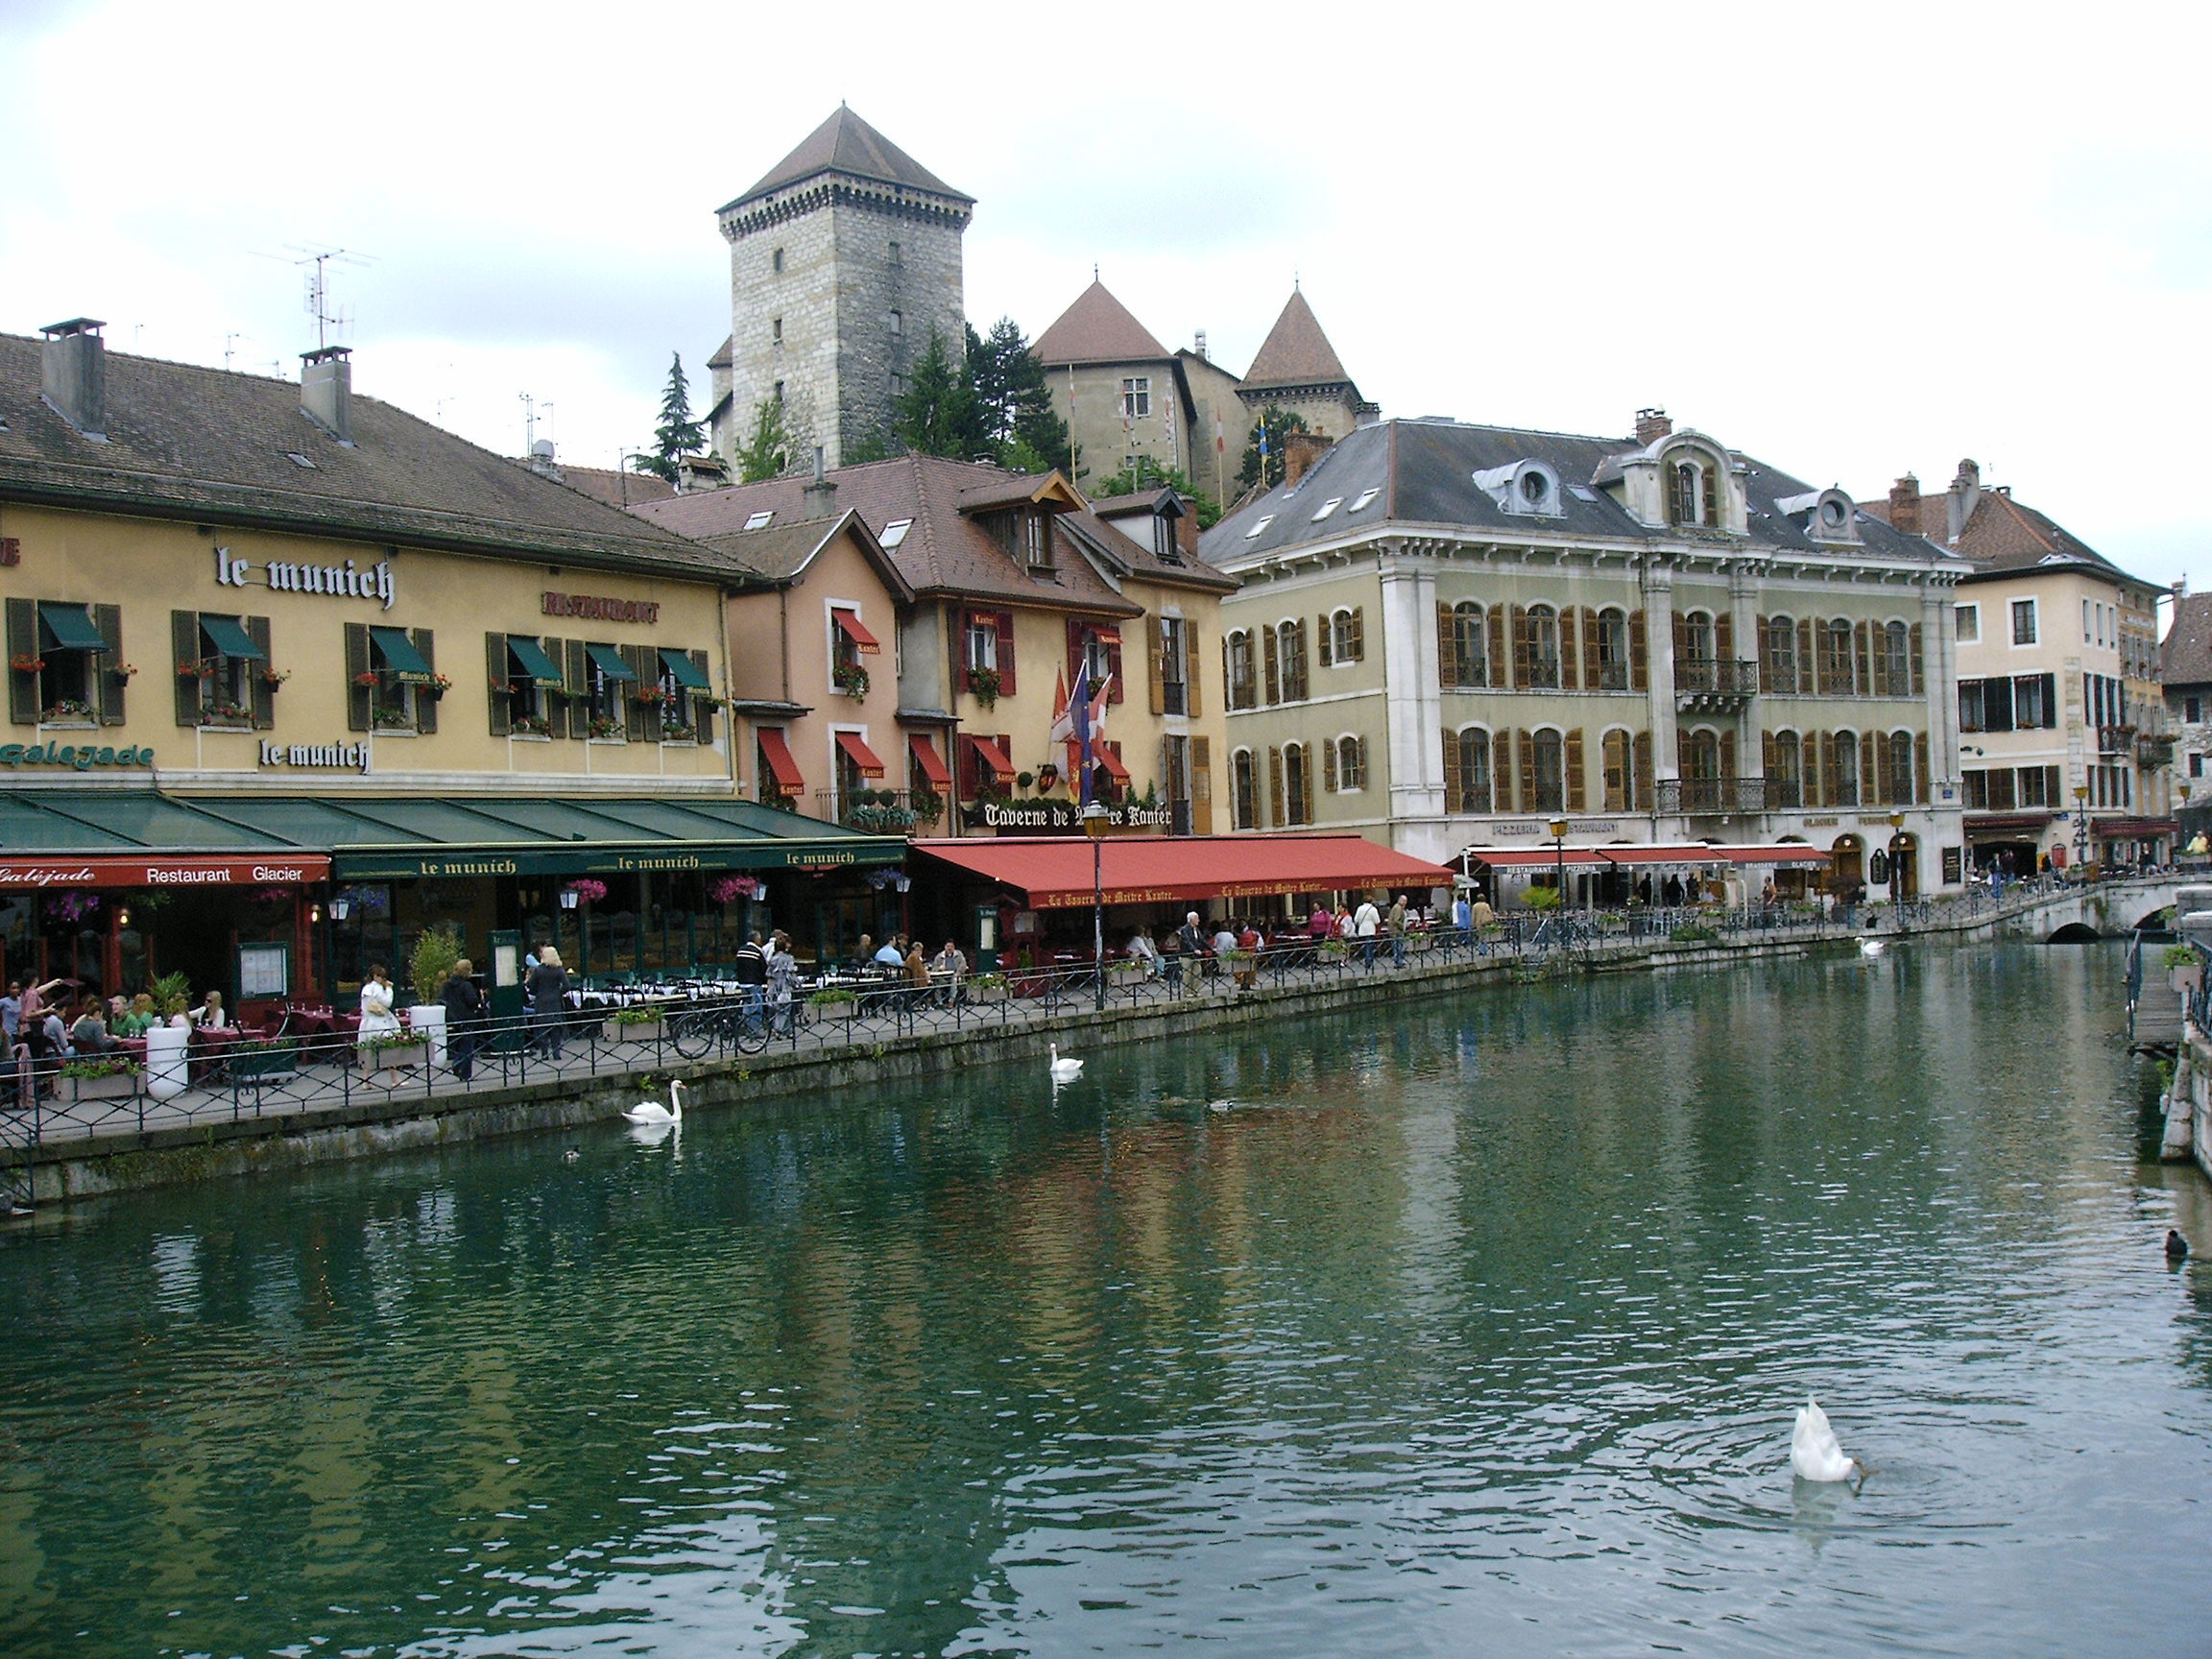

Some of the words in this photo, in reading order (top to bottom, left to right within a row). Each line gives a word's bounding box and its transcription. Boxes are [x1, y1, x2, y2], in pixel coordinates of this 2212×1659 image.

[215, 546, 250, 589] le
[266, 559, 395, 611] munich
[541, 591, 661, 624] RESTAURANT
[259, 737, 282, 766] le
[288, 739, 371, 775] munich
[984, 803, 1047, 827] Taverne
[1053, 806, 1069, 827] de
[1127, 805, 1171, 827] Kanter
[1492, 825, 1540, 835] PIZZERIA
[617, 857, 634, 869] le
[637, 855, 699, 870] munich
[786, 853, 800, 864] le
[803, 851, 855, 864] munich
[146, 868, 230, 883] Restaurant
[252, 866, 302, 881] Glacier
[421, 861, 438, 875] le
[445, 859, 517, 875] munich
[1065, 894, 1095, 905] Tavern
